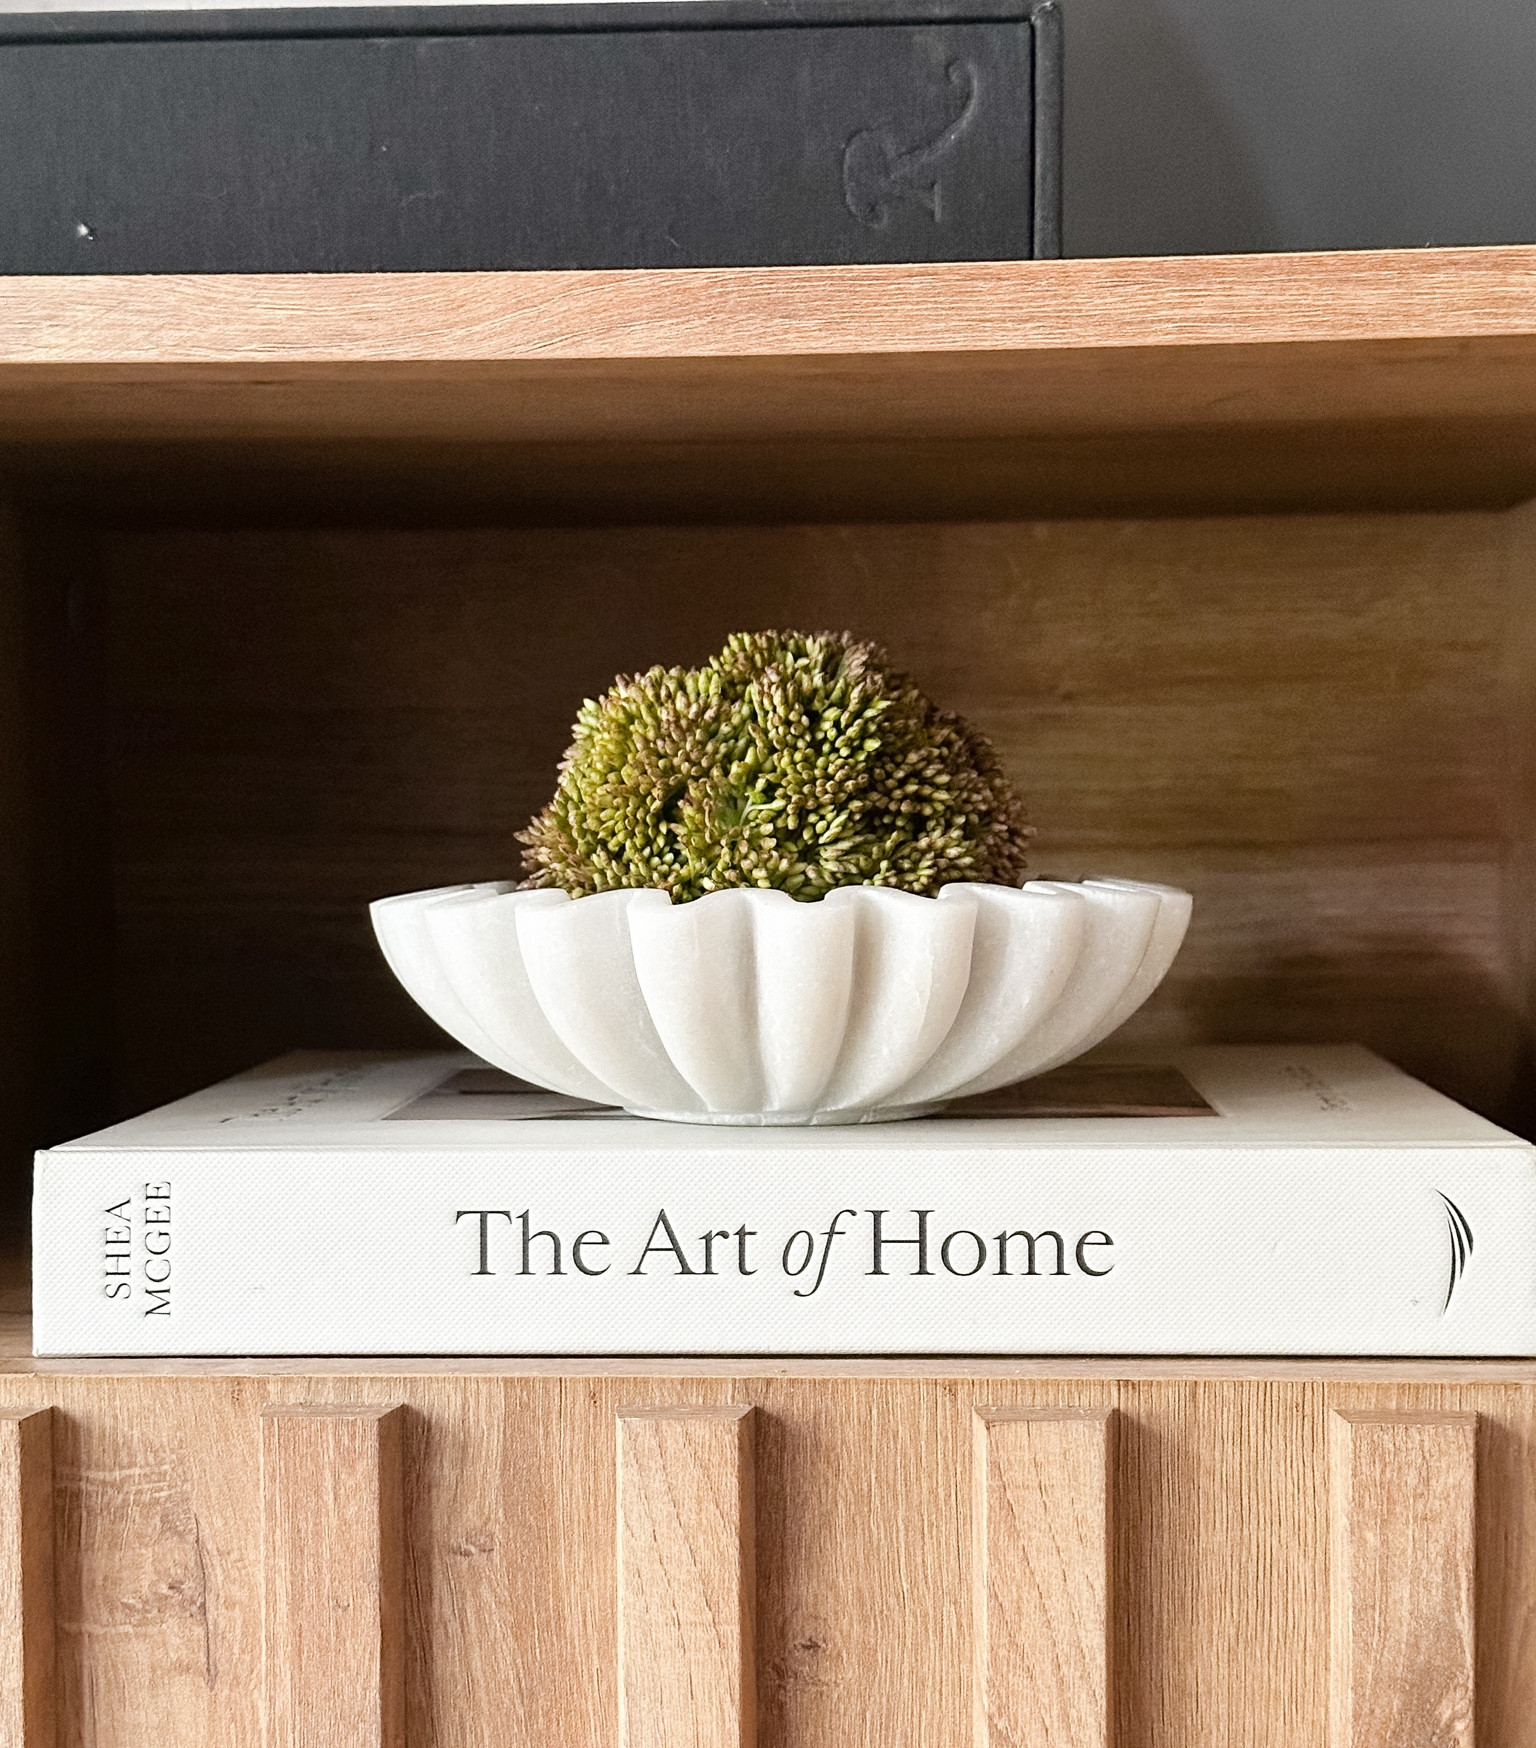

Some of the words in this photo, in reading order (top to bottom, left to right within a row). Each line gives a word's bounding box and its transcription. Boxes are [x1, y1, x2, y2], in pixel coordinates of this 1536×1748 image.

[104, 1197, 132, 1300] SHEA
[144, 1180, 172, 1318] MCGEE
[455, 1208, 612, 1277] The
[626, 1208, 758, 1277] Art
[782, 1209, 858, 1298] of
[864, 1209, 1115, 1277] Home
